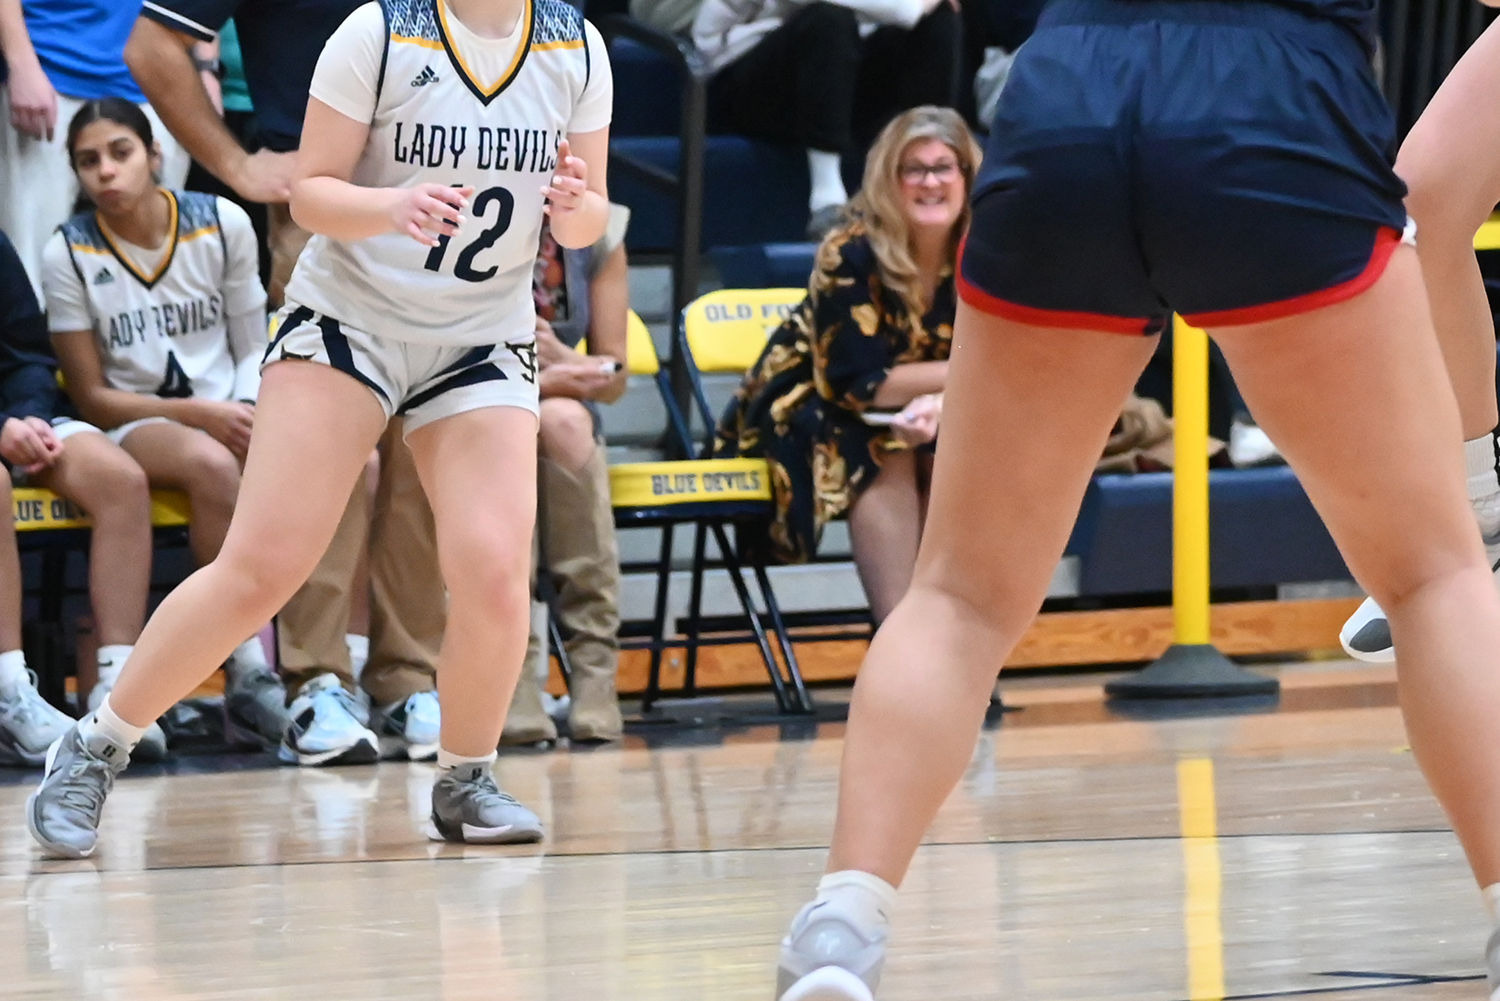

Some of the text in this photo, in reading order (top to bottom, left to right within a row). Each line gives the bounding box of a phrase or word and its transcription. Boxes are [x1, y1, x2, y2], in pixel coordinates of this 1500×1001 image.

[394, 122, 562, 173] LADY DEVILS
[424, 184, 514, 282] 12
[110, 309, 146, 348] ADY
[704, 304, 752, 322] OLD
[651, 471, 762, 496] BLUE DEVILS
